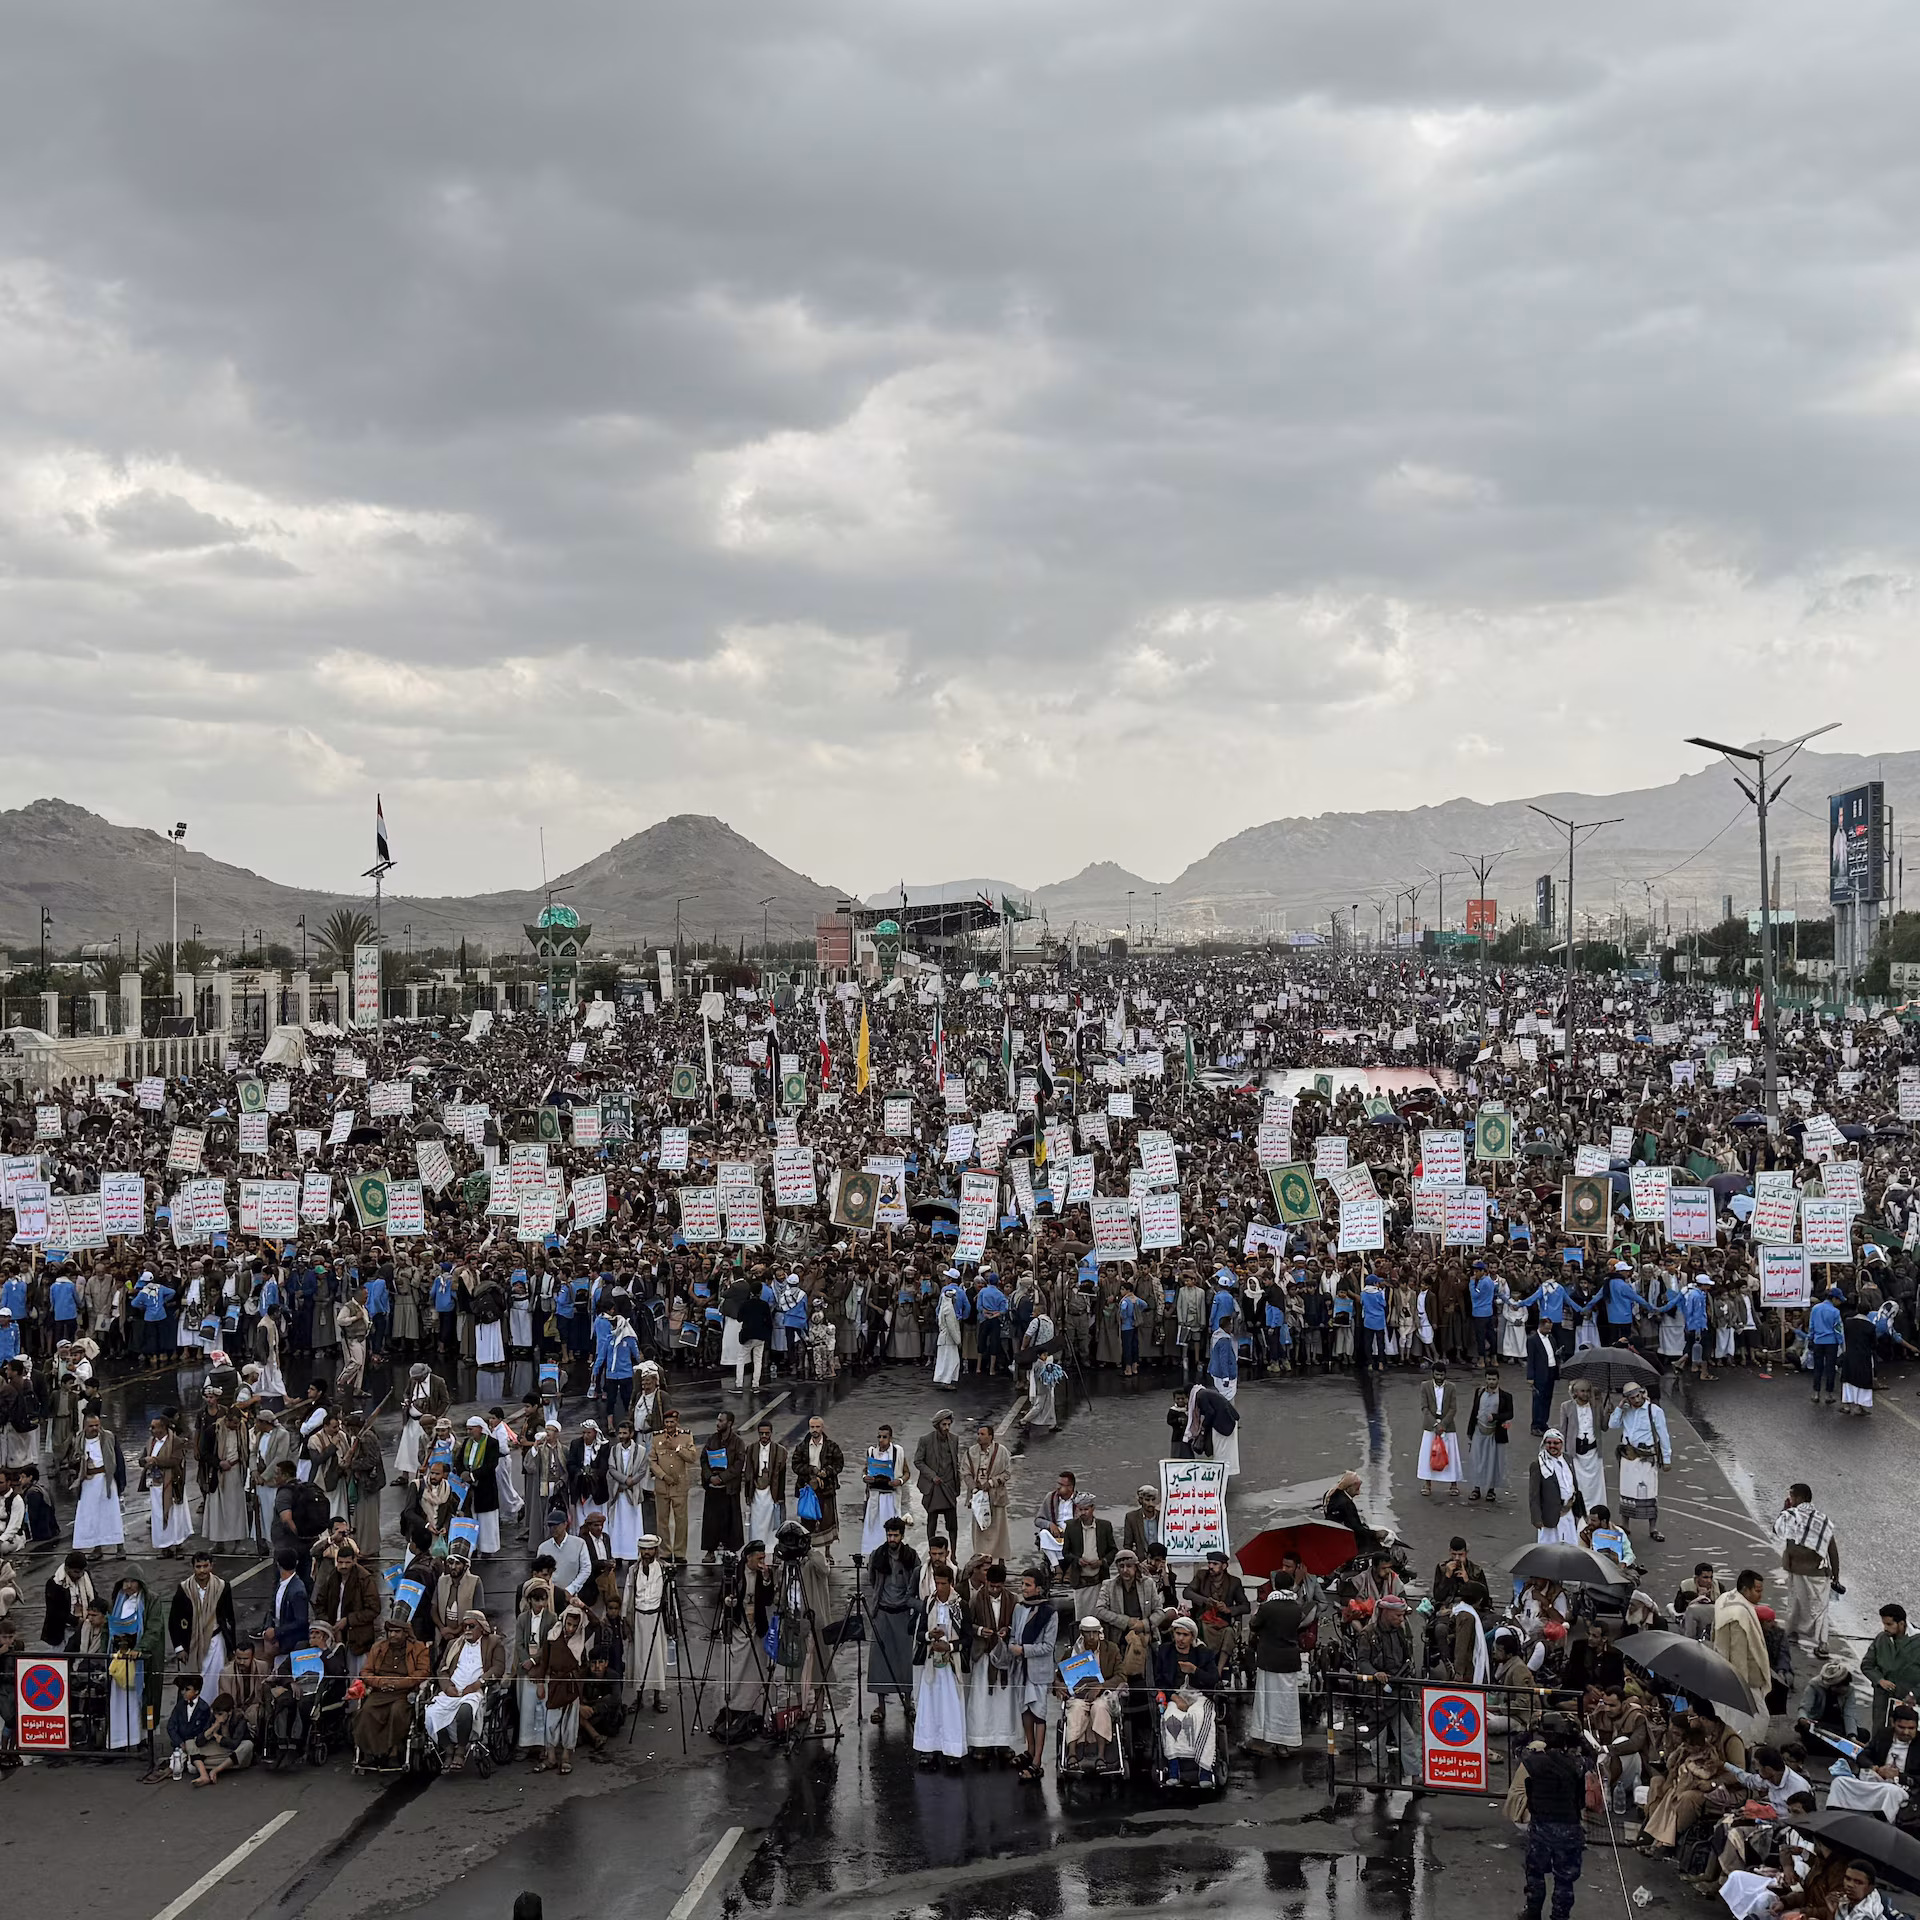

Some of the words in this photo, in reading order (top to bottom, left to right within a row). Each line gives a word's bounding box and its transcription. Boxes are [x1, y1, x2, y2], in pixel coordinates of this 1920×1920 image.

[1170, 1465, 1199, 1487] أكبر
[1201, 1467, 1220, 1481] الله
[1169, 1486, 1195, 1499] لأمريكا
[1198, 1488, 1218, 1499] الموت
[1198, 1504, 1219, 1515] الموت
[1166, 1520, 1187, 1532] اليهود
[1190, 1521, 1201, 1532] على
[1204, 1520, 1219, 1530] اللعنة
[1167, 1535, 1194, 1553] للإسلام
[1197, 1535, 1220, 1552] النصر
[23, 1720, 44, 1728] الوقوف
[26, 1731, 47, 1740] الضريح
[50, 1731, 63, 1740] أمام
[1431, 1755, 1456, 1764] الوقوف
[1434, 1769, 1459, 1777] الضريح
[1462, 1769, 1476, 1778] أمام
